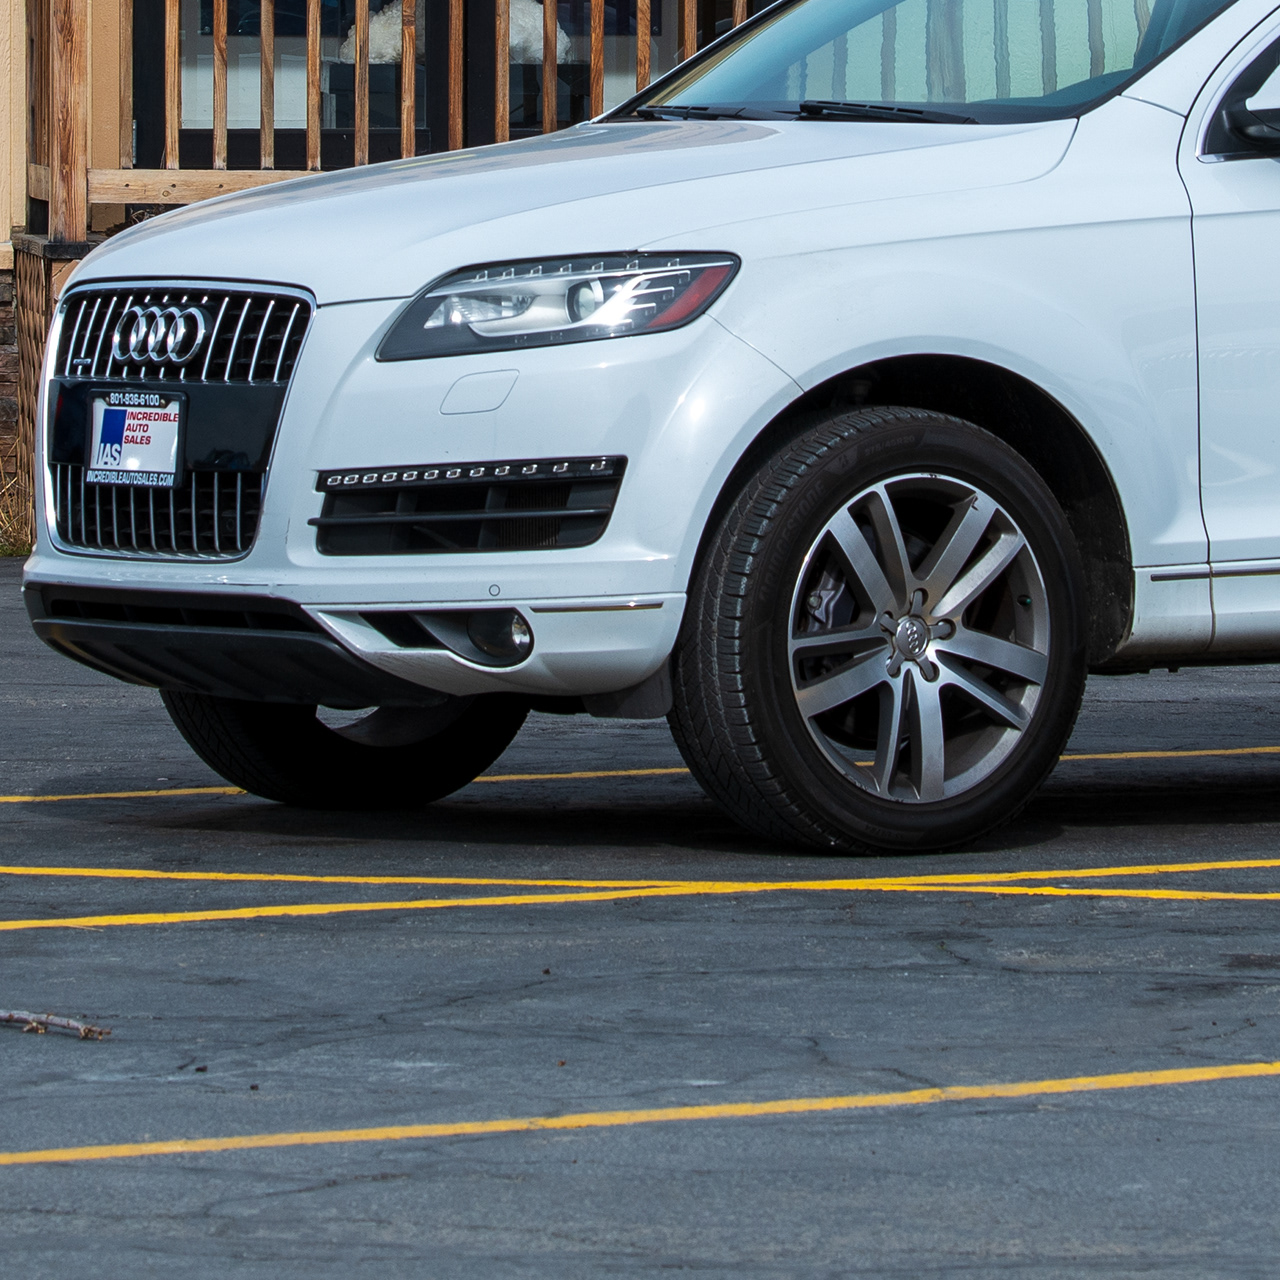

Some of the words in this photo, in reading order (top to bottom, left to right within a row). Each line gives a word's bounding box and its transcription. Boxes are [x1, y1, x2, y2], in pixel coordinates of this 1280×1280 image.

[110, 393, 160, 406] 801-936-6100
[127, 412, 178, 422] INCREDIBLE
[126, 424, 149, 432] AUTO
[124, 435, 151, 445] SALES
[98, 443, 121, 465] IAS
[86, 470, 174, 486] INCREDIBLEAUTOSALES.COM
